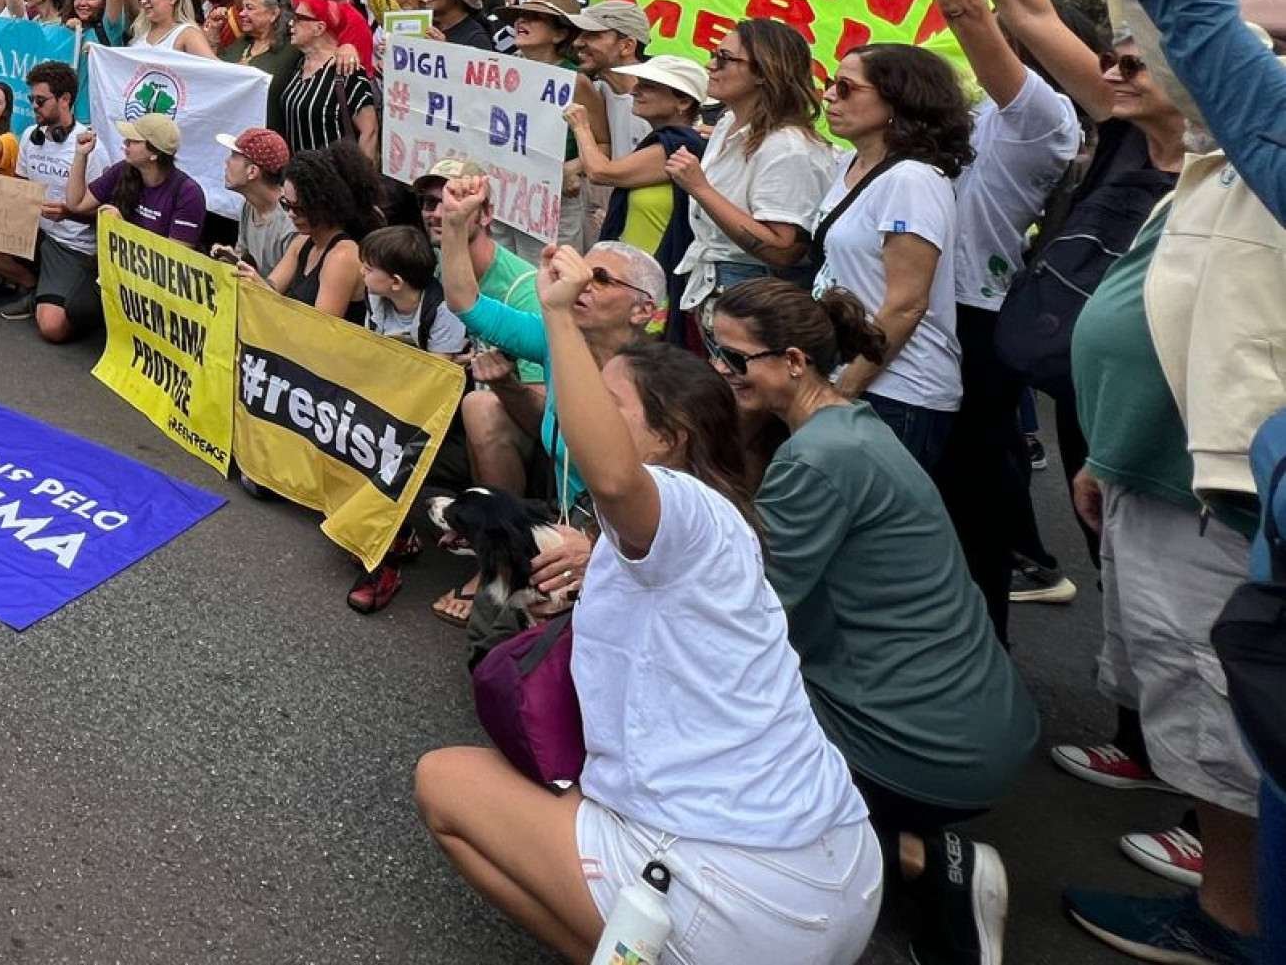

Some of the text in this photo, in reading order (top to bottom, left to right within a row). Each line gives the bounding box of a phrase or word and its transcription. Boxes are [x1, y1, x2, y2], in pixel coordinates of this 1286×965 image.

[392, 44, 571, 106] DIGA NÃO AO
[425, 91, 461, 133] PL
[488, 104, 528, 156] DA
[37, 162, 70, 178] CLIMA
[107, 231, 219, 318] PRESIDENTE,
[119, 283, 207, 367] QUEM AMA
[130, 334, 193, 418] PROTEGE
[31, 476, 130, 532] PELO
